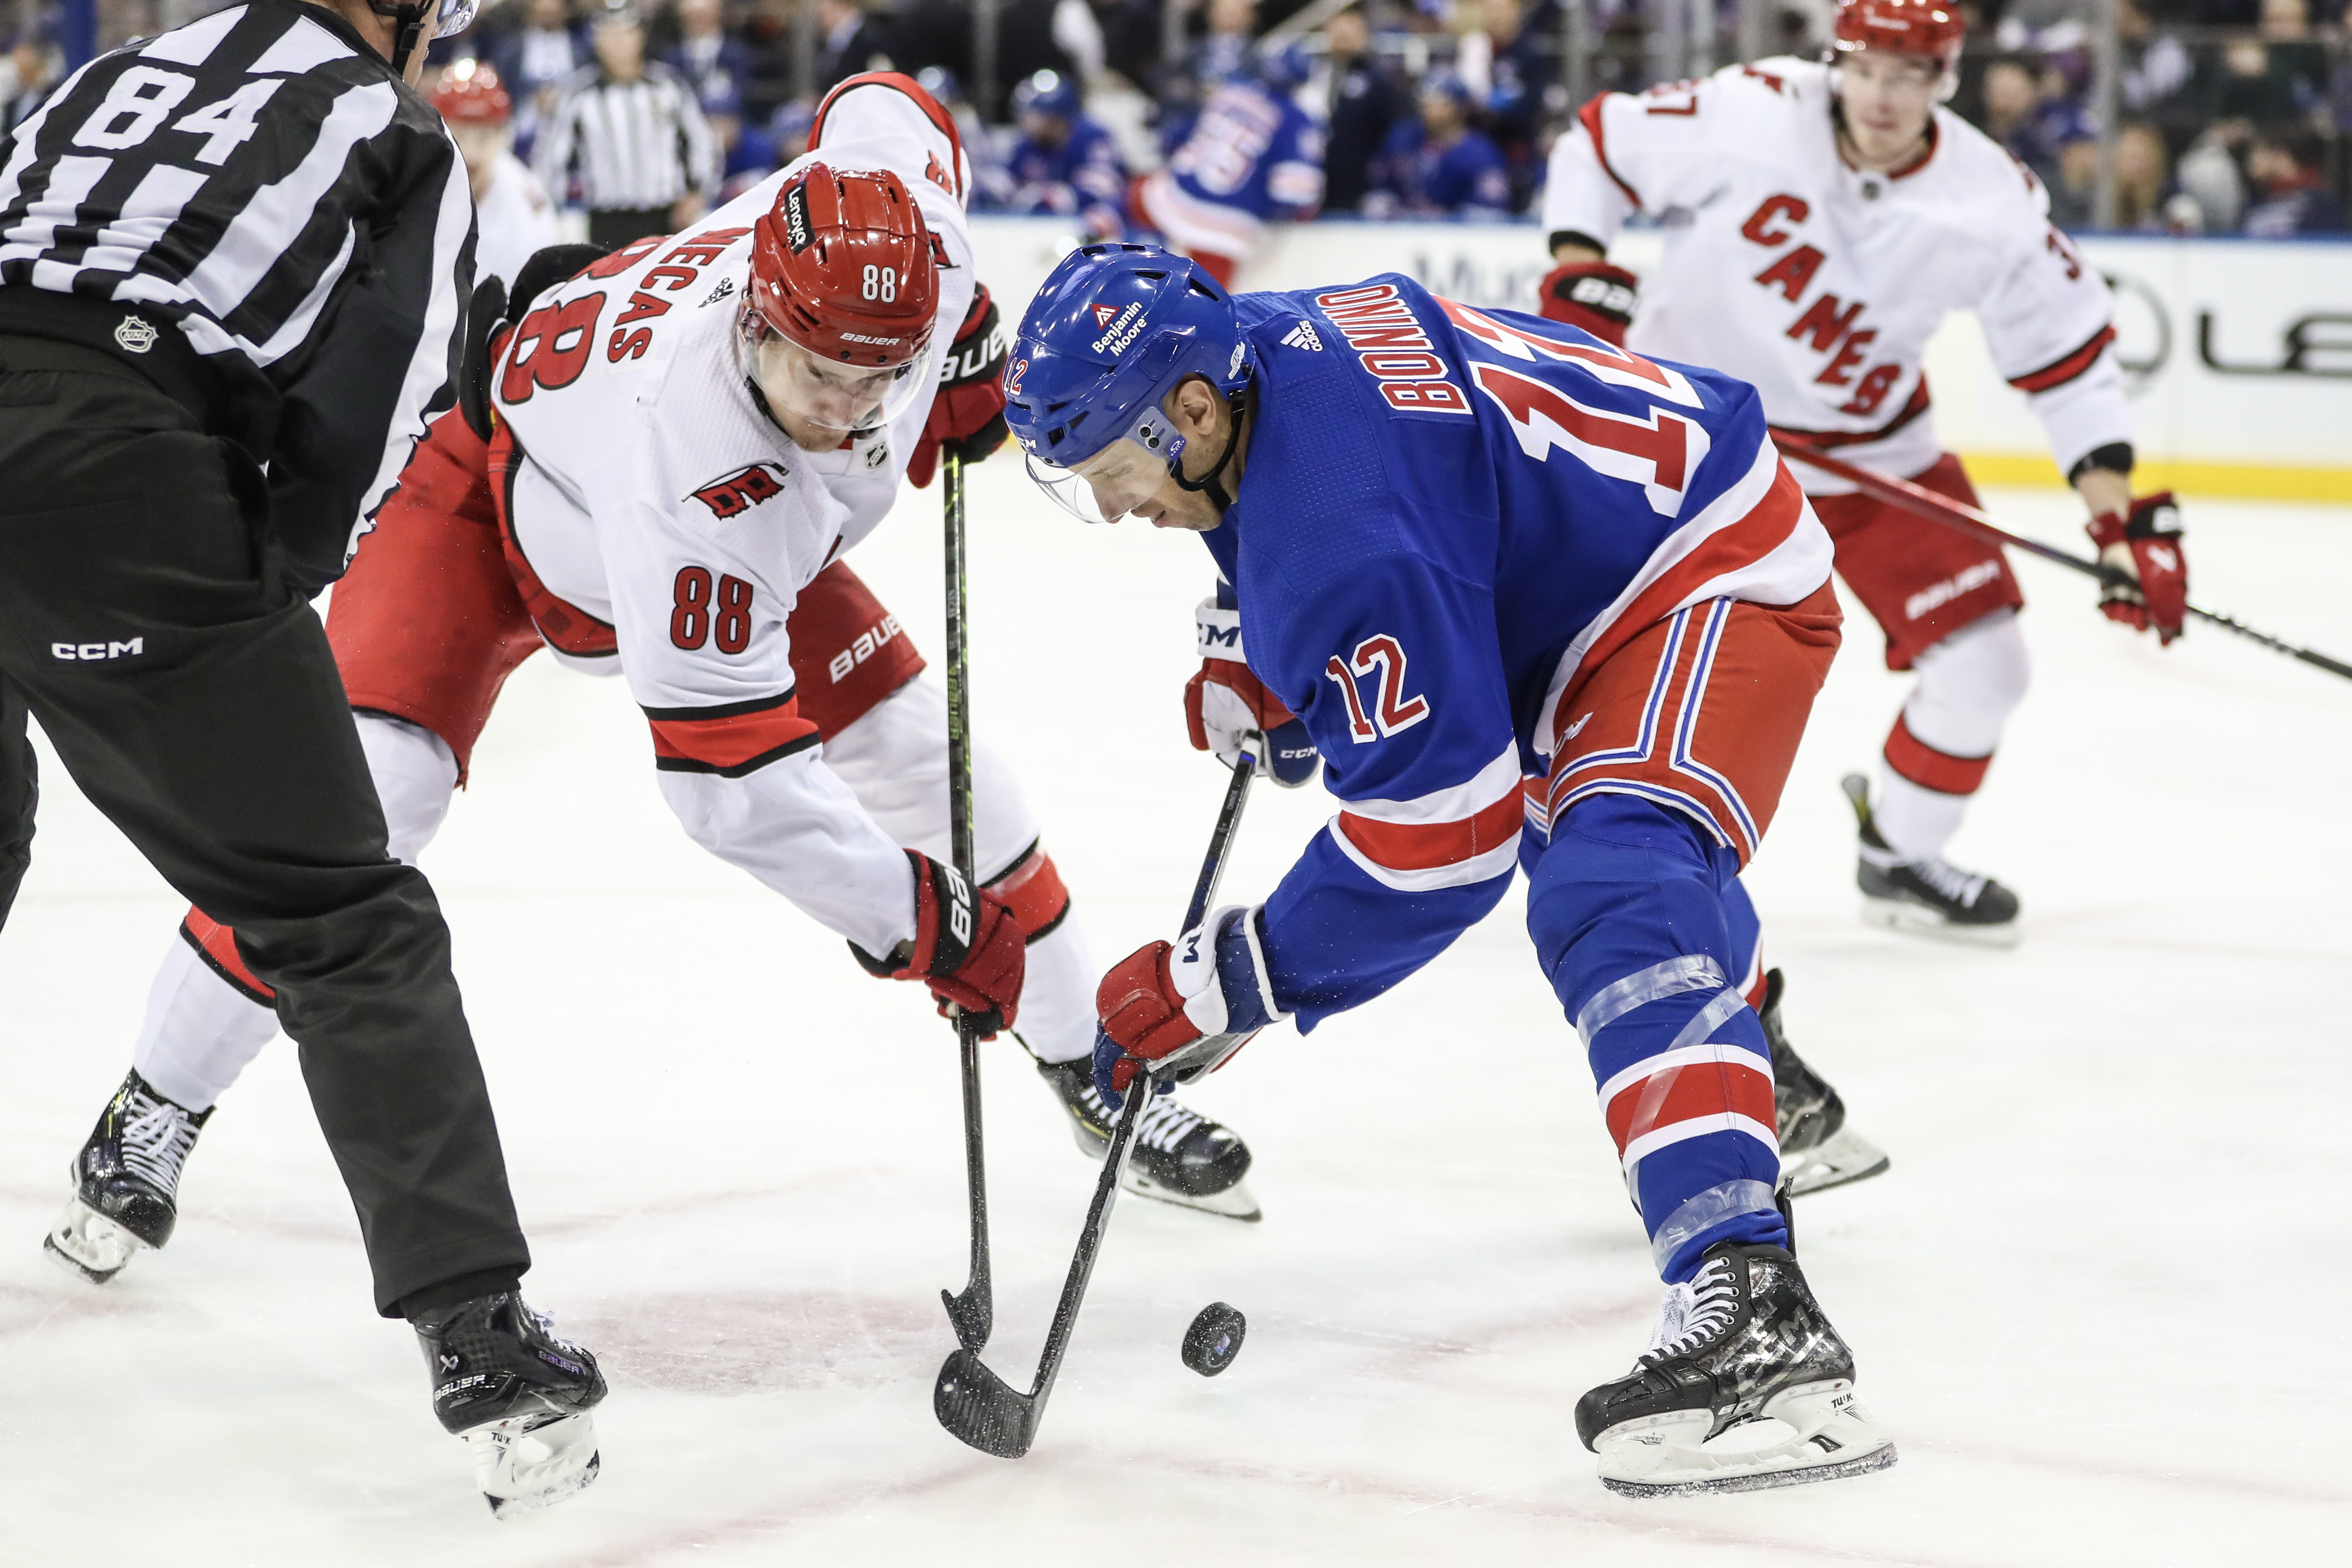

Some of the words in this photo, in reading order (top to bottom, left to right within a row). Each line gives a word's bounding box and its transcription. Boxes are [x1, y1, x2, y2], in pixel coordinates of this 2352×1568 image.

[72, 65, 286, 166] 84
[788, 186, 807, 245] Lenovo
[607, 227, 755, 363] NECAS
[698, 277, 730, 308] adidas
[862, 264, 896, 304] 88
[1740, 194, 1902, 416] CANES
[122, 330, 151, 341] NHL
[1091, 301, 1143, 354] Benjamin
[1109, 318, 1147, 357] Moore
[1299, 320, 1323, 352] adidas
[1315, 283, 1474, 415] BONINO
[1004, 357, 1029, 396] 12
[670, 565, 754, 655] 88
[51, 636, 144, 660] CCM
[1324, 632, 1431, 744] 12
[945, 866, 972, 948] BA
